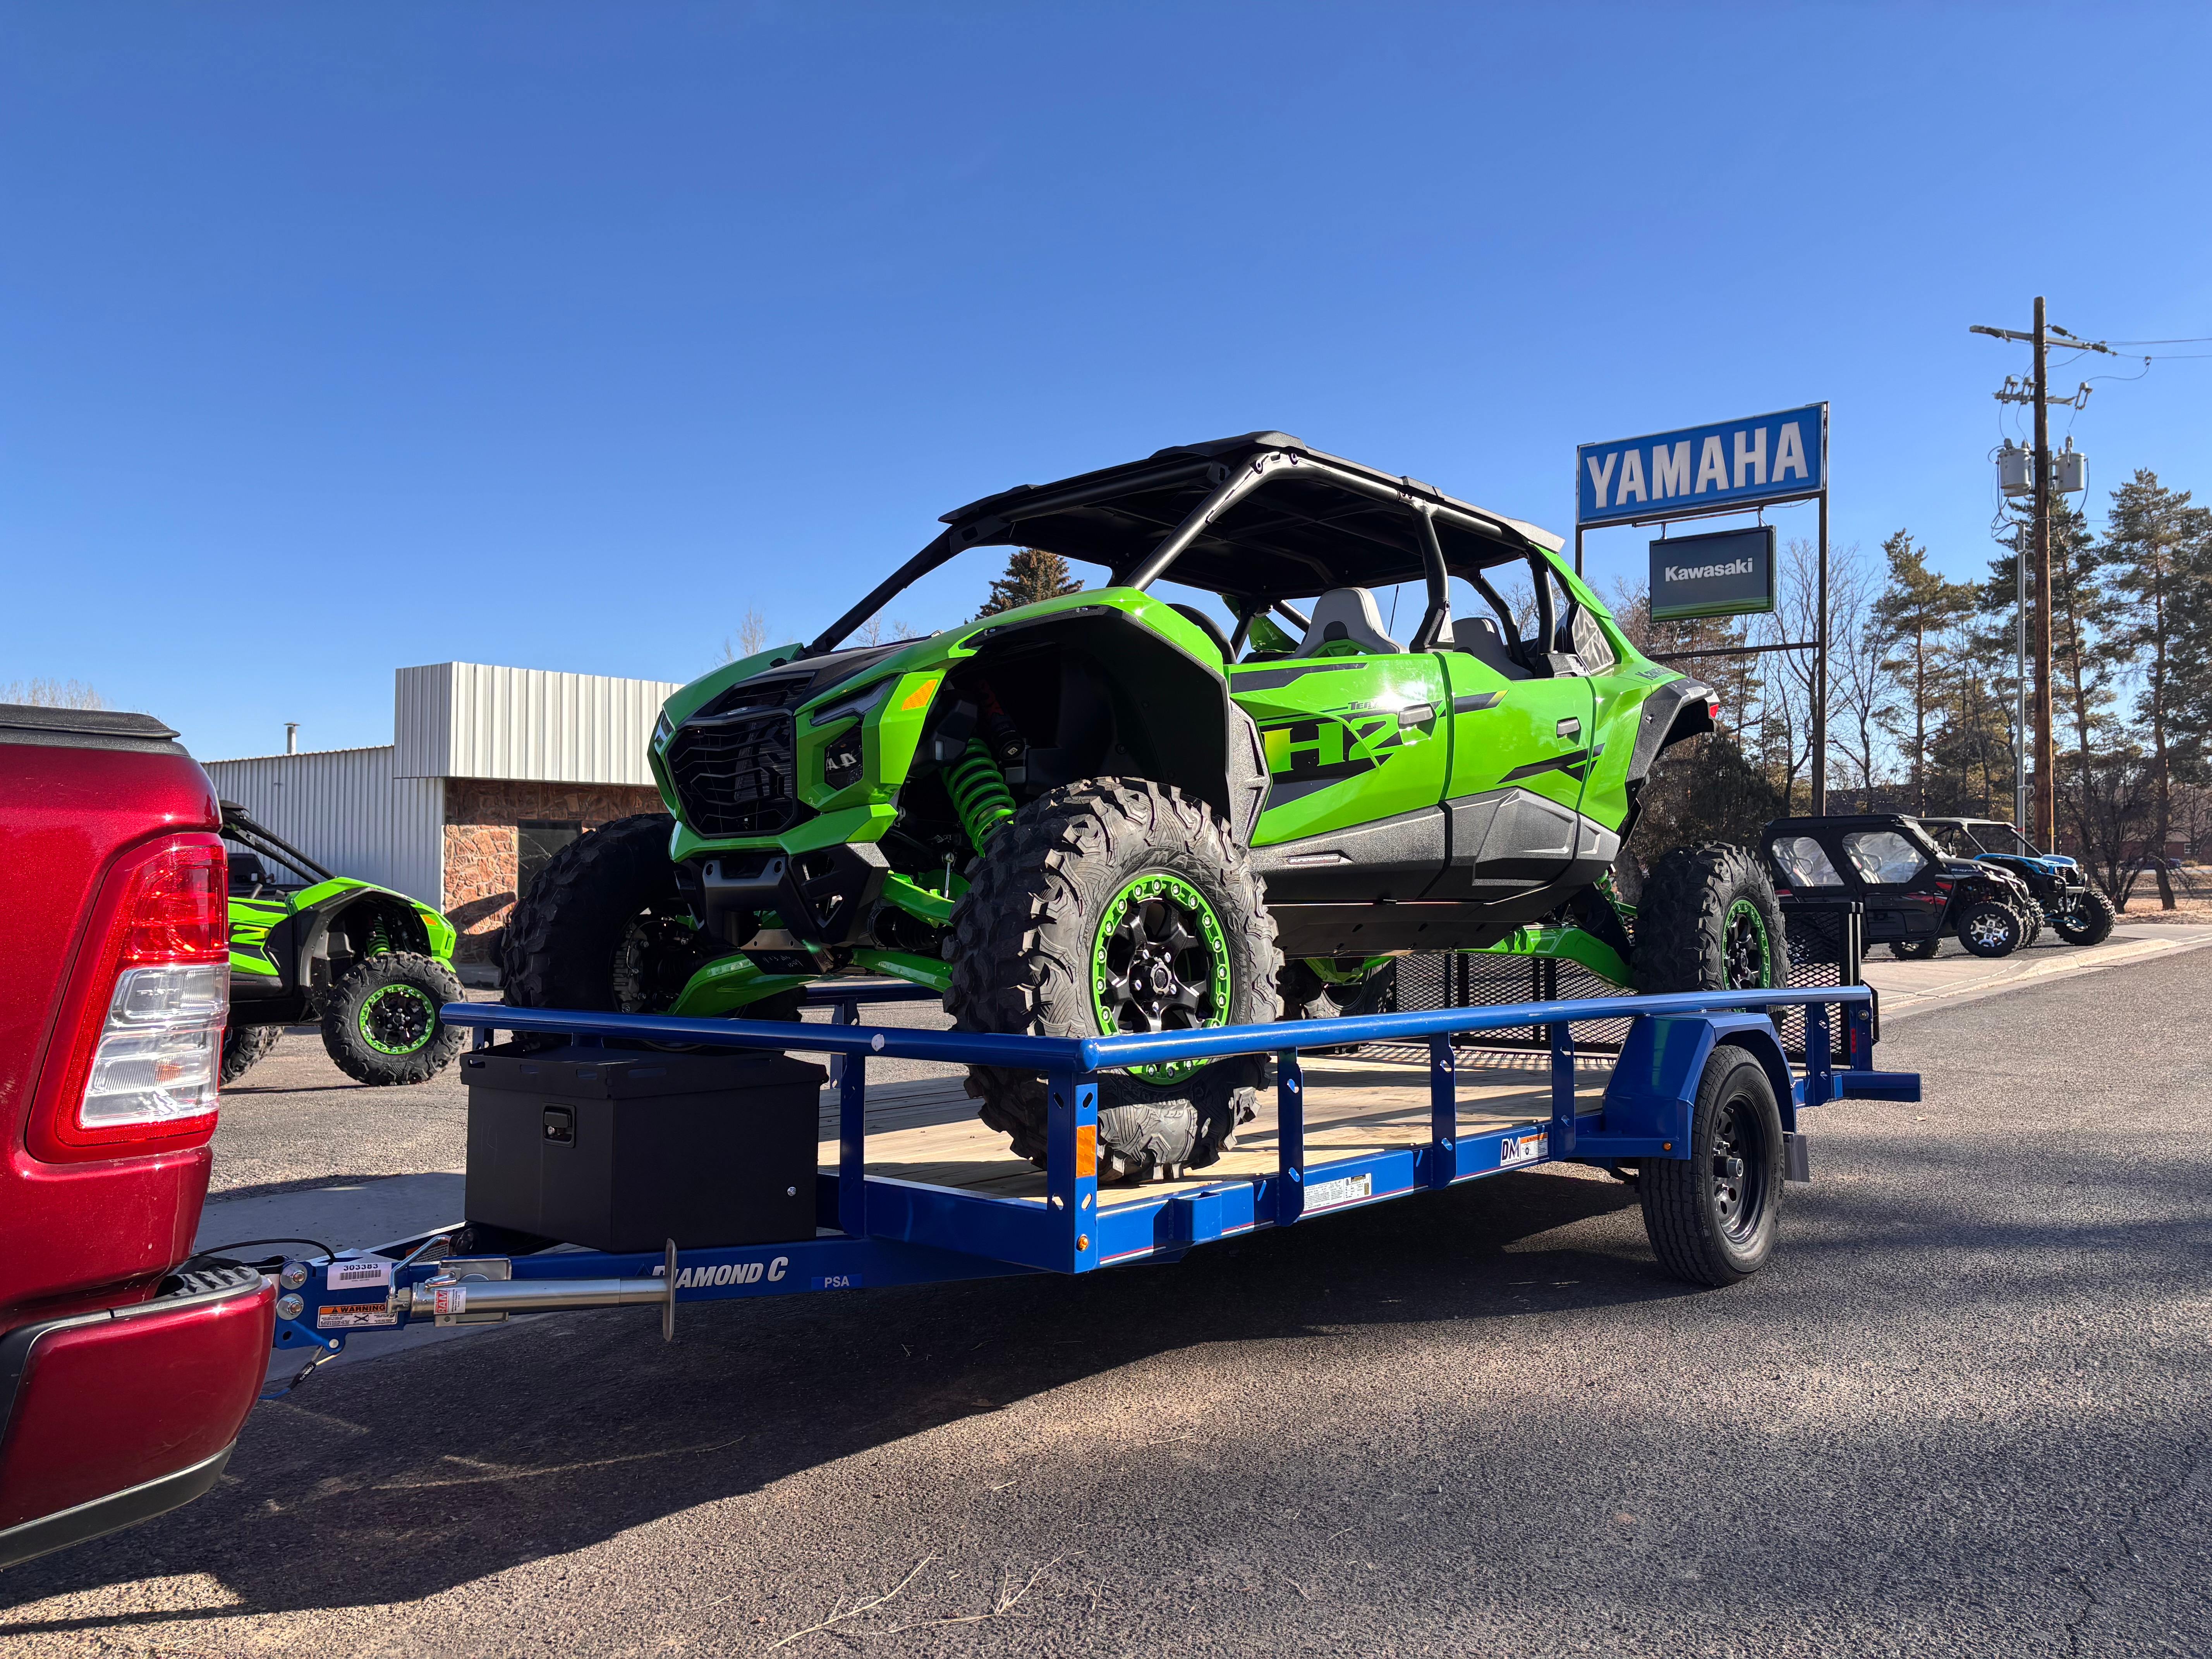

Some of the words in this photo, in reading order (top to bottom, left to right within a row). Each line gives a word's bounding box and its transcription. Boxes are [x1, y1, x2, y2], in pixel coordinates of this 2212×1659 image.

[1587, 422, 1808, 509] YAMAHA
[1665, 558, 1753, 582] Kawasaki
[1261, 713, 1405, 774] H2
[1238, 997, 1247, 1019] RADIAL
[1501, 1138, 1520, 1160] DM
[768, 1257, 788, 1281] C
[824, 1276, 850, 1288] PSA
[438, 1291, 447, 1312] RAM
